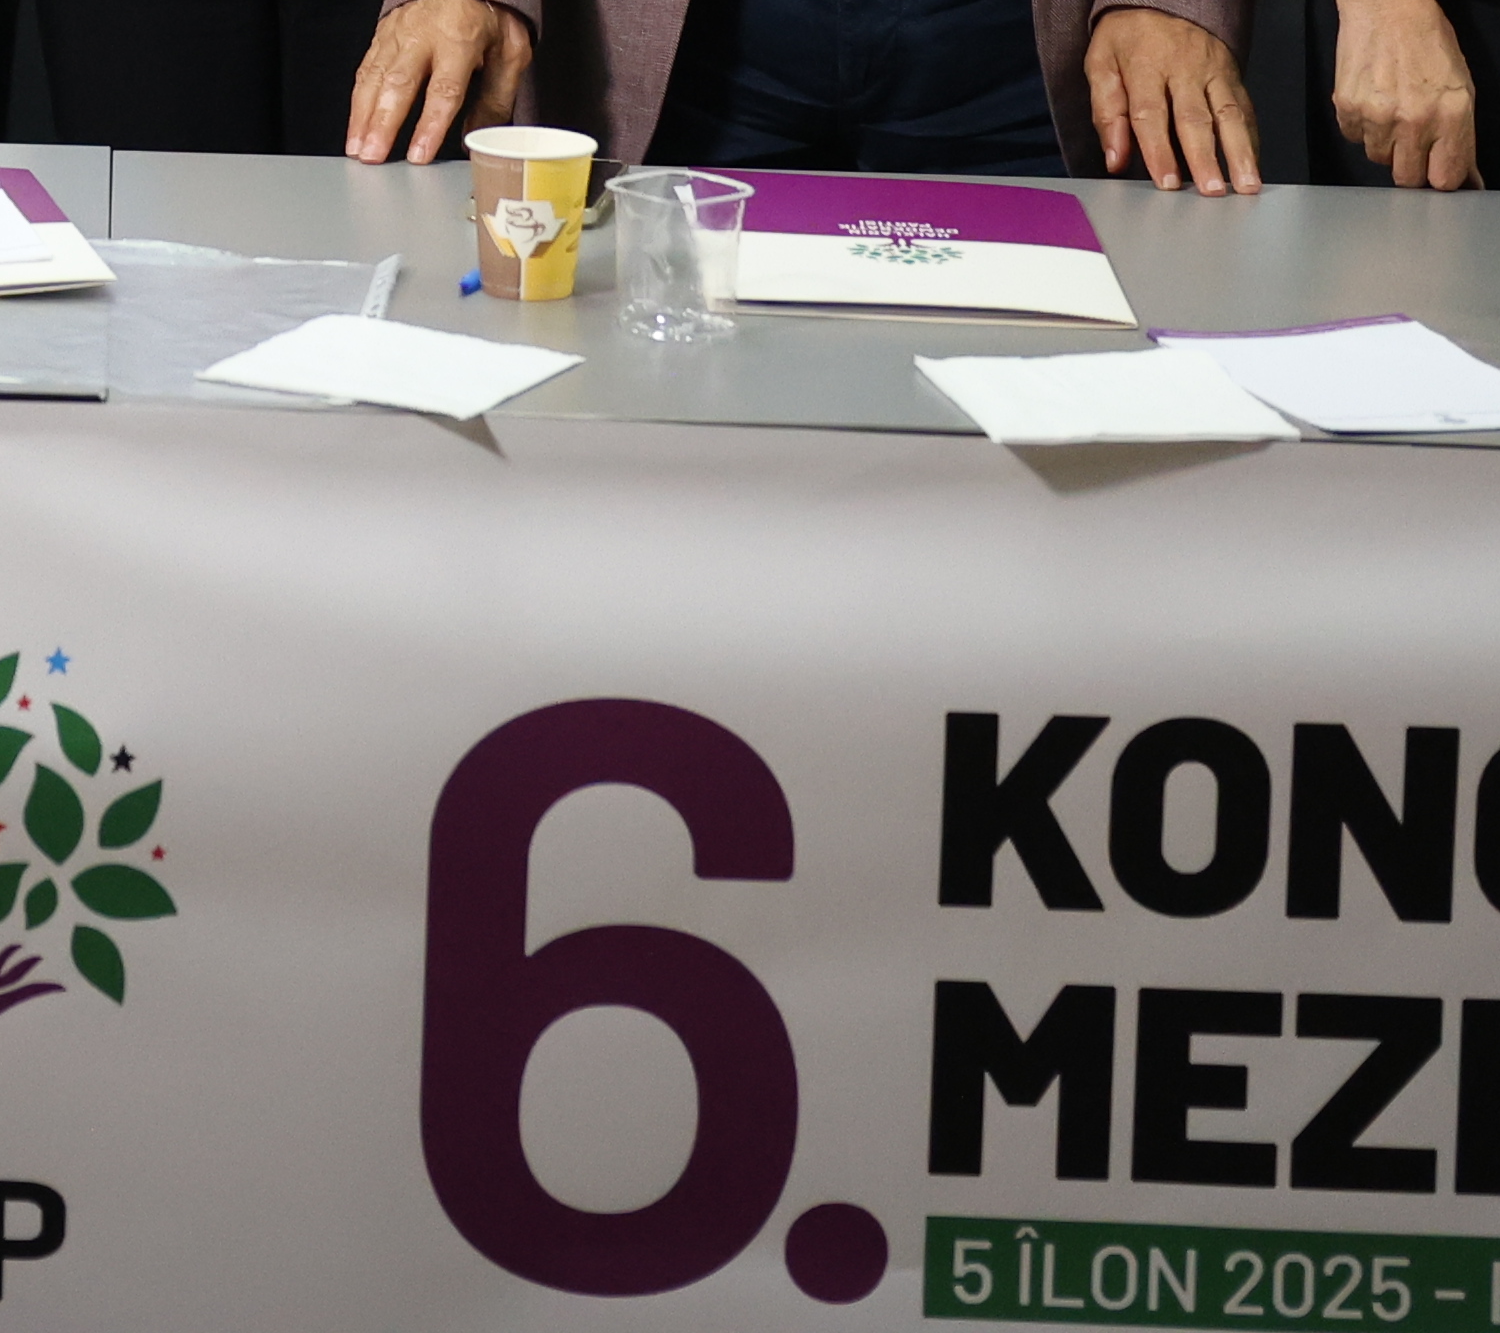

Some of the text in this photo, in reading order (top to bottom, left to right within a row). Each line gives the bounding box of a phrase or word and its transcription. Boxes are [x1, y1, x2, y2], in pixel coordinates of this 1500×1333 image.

[418, 696, 890, 1306] 6.
[951, 1238, 994, 1305] 5
[1012, 1224, 1200, 1313] ÎLON
[1221, 1248, 1413, 1323] 2025
